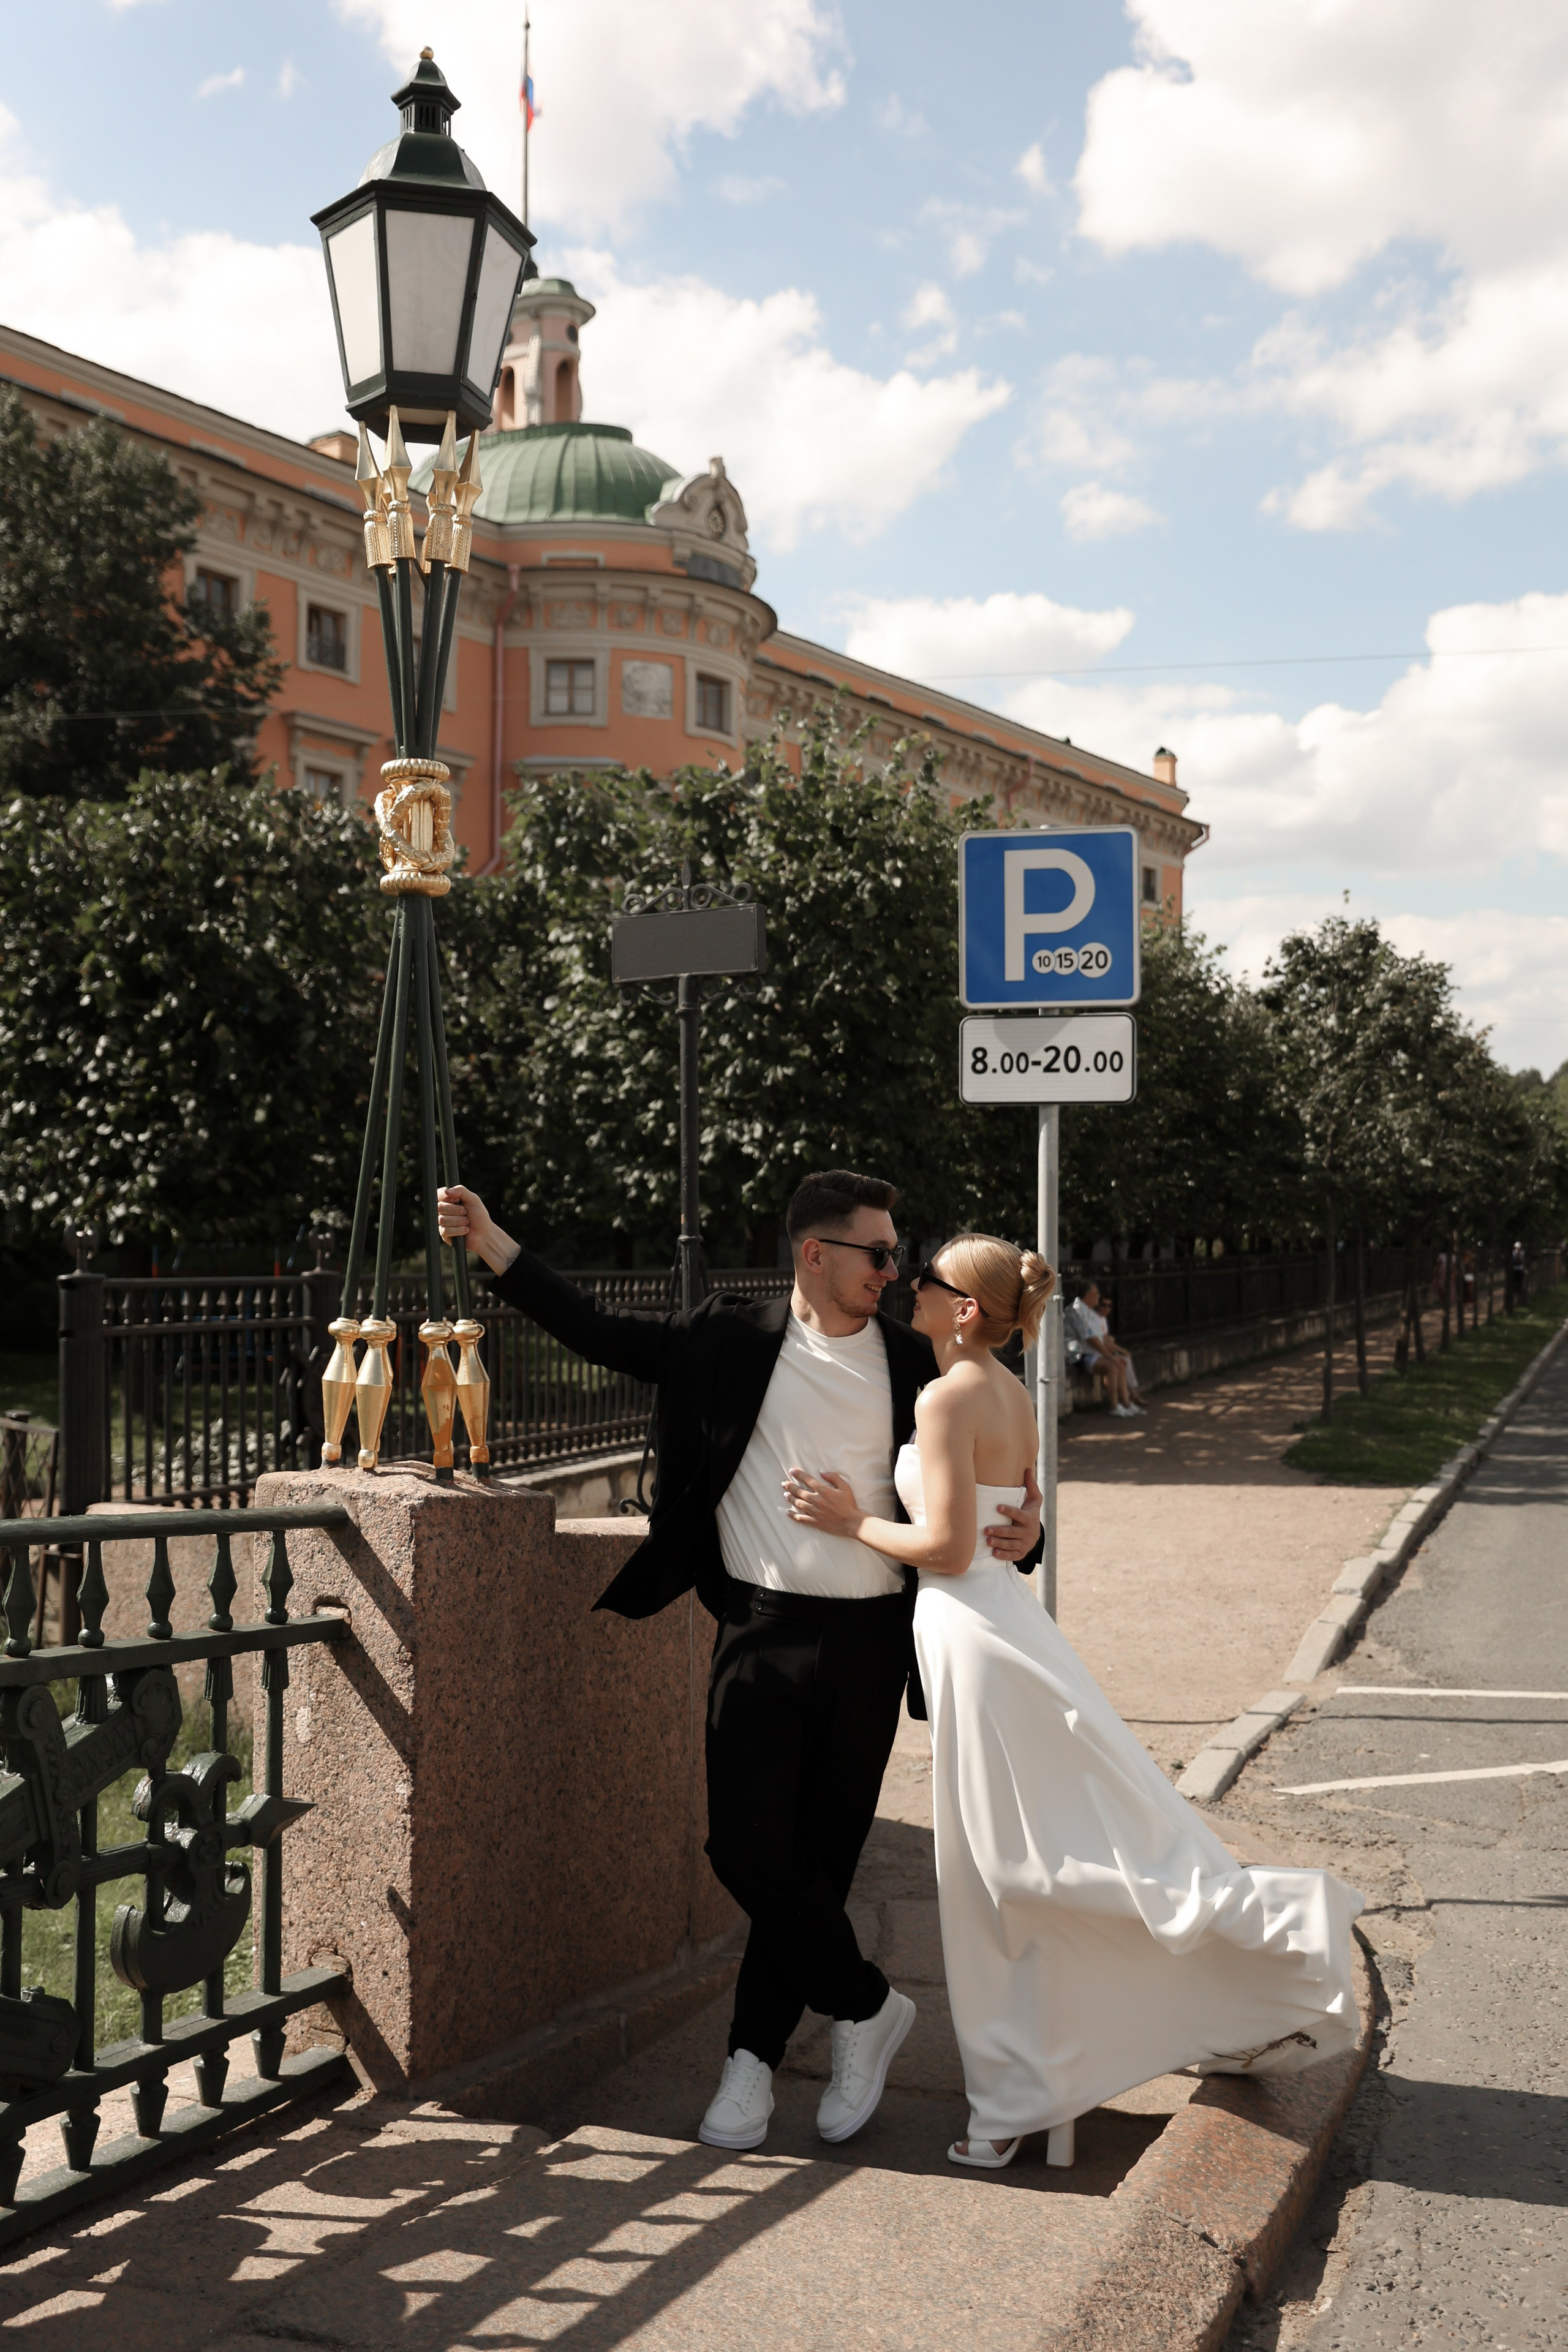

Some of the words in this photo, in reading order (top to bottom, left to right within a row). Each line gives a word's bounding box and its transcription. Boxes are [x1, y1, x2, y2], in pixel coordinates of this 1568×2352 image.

[1004, 848, 1096, 981] P
[1037, 956, 1051, 968] 10
[1057, 952, 1074, 969] 15
[1080, 950, 1108, 970] 20
[970, 1045, 1123, 1074] 8.00-20.00
